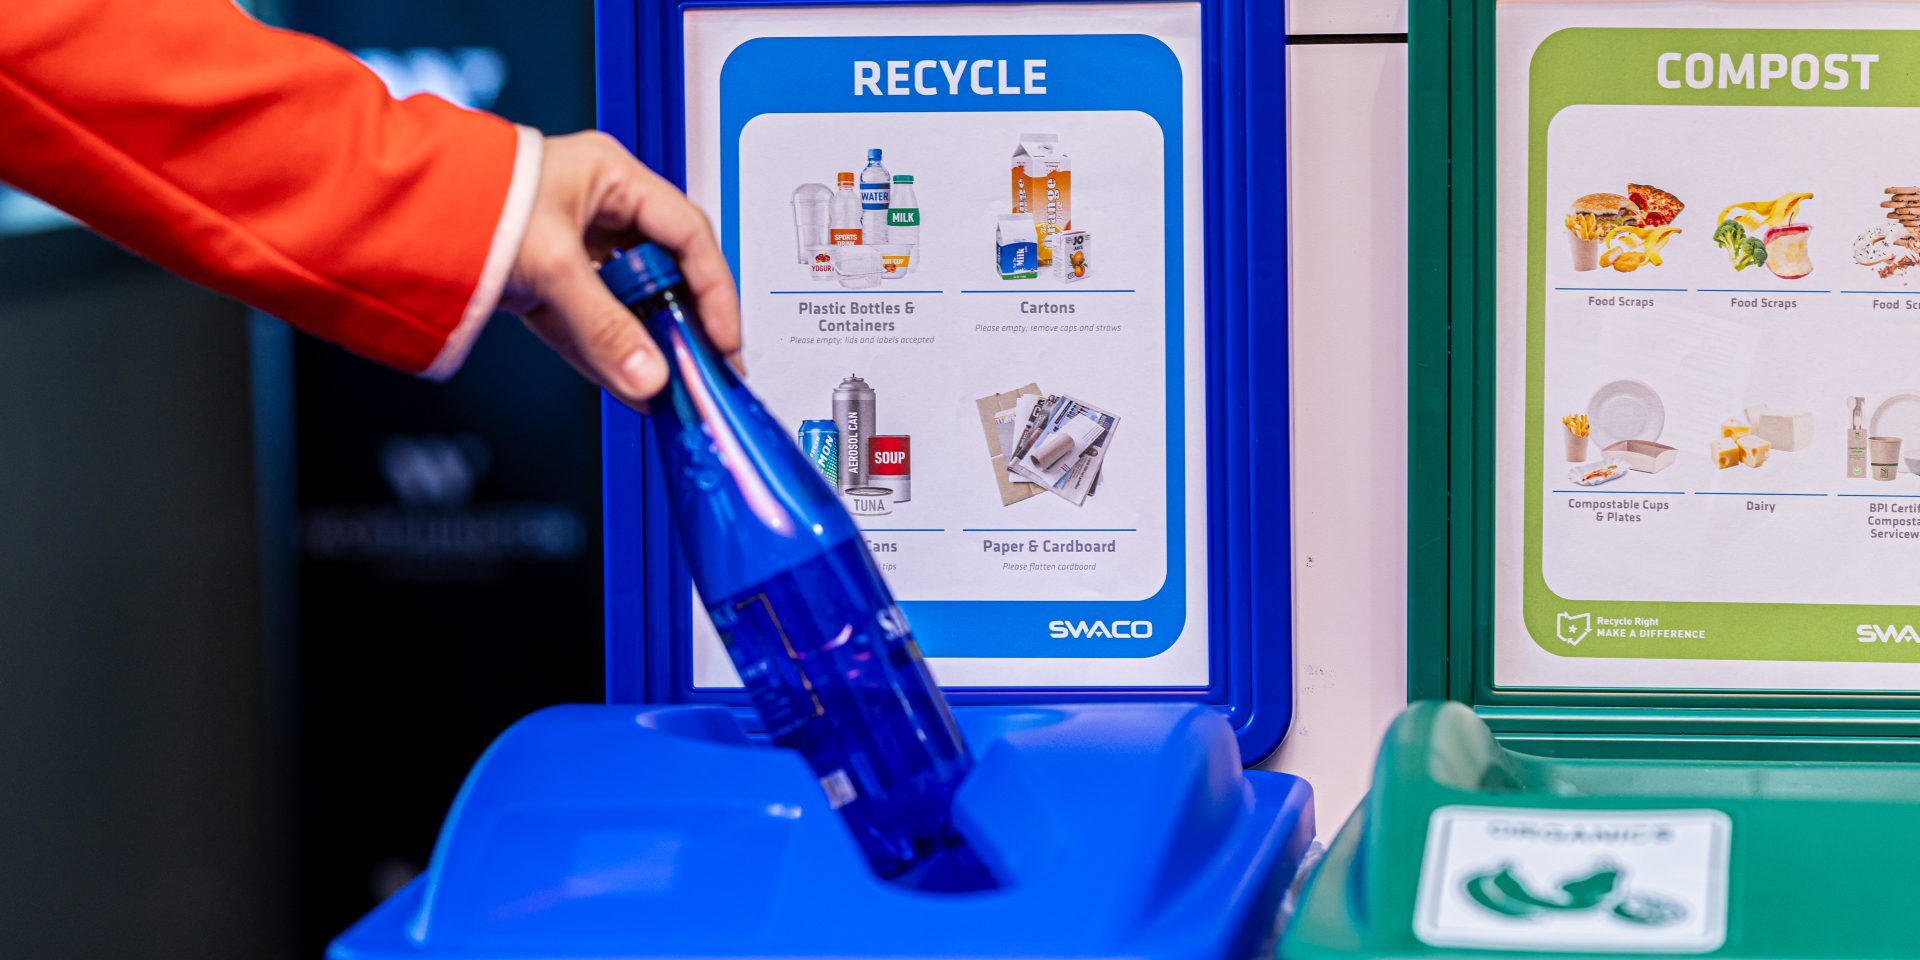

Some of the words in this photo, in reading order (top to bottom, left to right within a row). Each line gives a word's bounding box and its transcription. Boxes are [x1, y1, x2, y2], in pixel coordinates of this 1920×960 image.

[1657, 52, 1880, 90] COMPOST
[854, 59, 1047, 96] RECYCLE
[861, 192, 889, 201] WATER
[892, 212, 914, 223] MILK
[1073, 235, 1084, 246] JO
[799, 301, 846, 315] Plastic
[850, 301, 900, 315] Bottles
[905, 301, 915, 314] &
[1020, 301, 1076, 314] Cartons
[1588, 297, 1615, 306] Food
[1618, 297, 1654, 309] Scraps
[1731, 298, 1758, 308] Food
[1760, 298, 1797, 310] Scraps
[1873, 299, 1899, 309] Food
[818, 318, 895, 332] Containers
[975, 324, 1000, 332] Please
[1060, 325, 1077, 333] caps
[1080, 324, 1094, 332] and
[1096, 324, 1121, 332] straws
[790, 336, 815, 344] Please
[845, 336, 858, 344] lids
[860, 336, 874, 344] and
[877, 336, 899, 344] labels
[900, 336, 935, 345] accepted
[848, 411, 858, 431] CAN
[848, 434, 858, 474] AEROSOL
[874, 451, 906, 464] SOUP
[853, 499, 885, 512] TUNA
[1568, 498, 1640, 511] Compostable
[1642, 499, 1669, 511] Cups
[1747, 501, 1776, 513] Dairy
[1869, 503, 1888, 513] BPI
[1595, 512, 1604, 522] &
[1607, 512, 1641, 522] Plates
[1870, 529, 1920, 539] Servicew
[983, 539, 1024, 556] Paper
[1028, 540, 1039, 553] &
[1043, 539, 1116, 553] Cardboard
[882, 562, 897, 571] tips
[1002, 562, 1028, 571] Please
[1029, 562, 1056, 572] flatten
[1058, 562, 1097, 571] cardboard
[1597, 617, 1632, 627] Recycle
[1634, 617, 1659, 628] Right
[1048, 620, 1153, 639] SWACO
[1597, 628, 1626, 638] MAKE
[1629, 629, 1636, 638] A
[1640, 629, 1705, 639] DIFFERENCE
